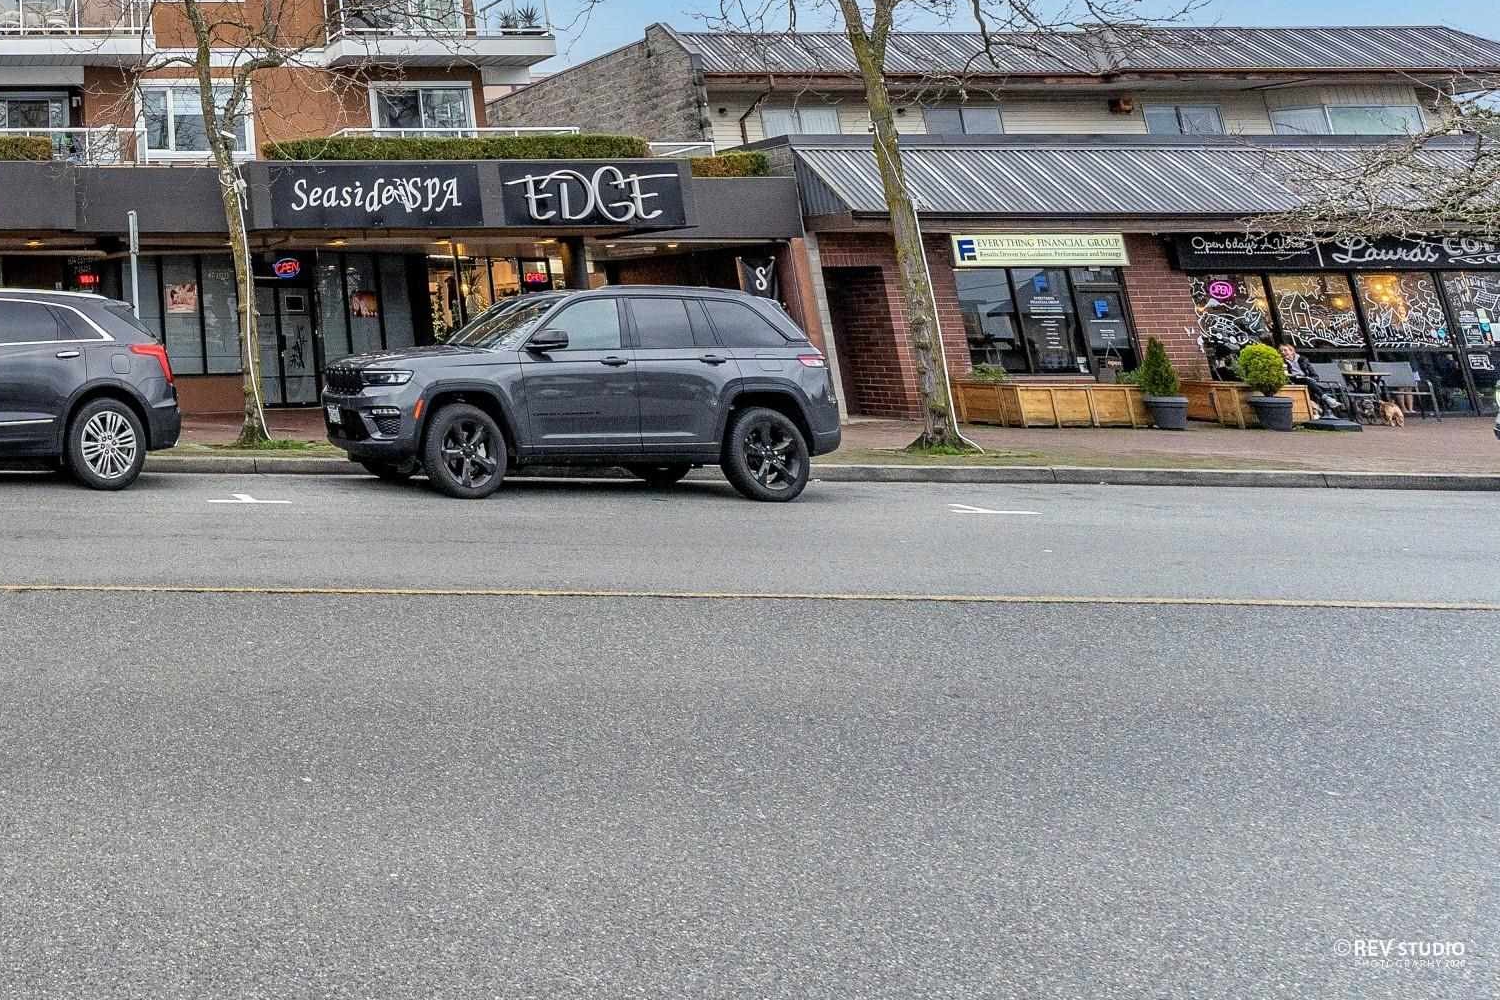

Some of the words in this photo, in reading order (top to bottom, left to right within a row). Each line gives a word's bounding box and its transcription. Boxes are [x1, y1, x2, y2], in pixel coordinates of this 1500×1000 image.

[291, 177, 395, 213] Seaside
[407, 176, 462, 212] SPA
[504, 166, 678, 222] EDGE
[977, 238, 1035, 248] EVERYTHING
[1037, 238, 1085, 248] FINANCIAL
[1087, 238, 1120, 248] GROUP
[1191, 236, 1225, 253] Open
[1225, 237, 1232, 249] 6
[275, 261, 300, 274] OPEN
[755, 266, 768, 290] S
